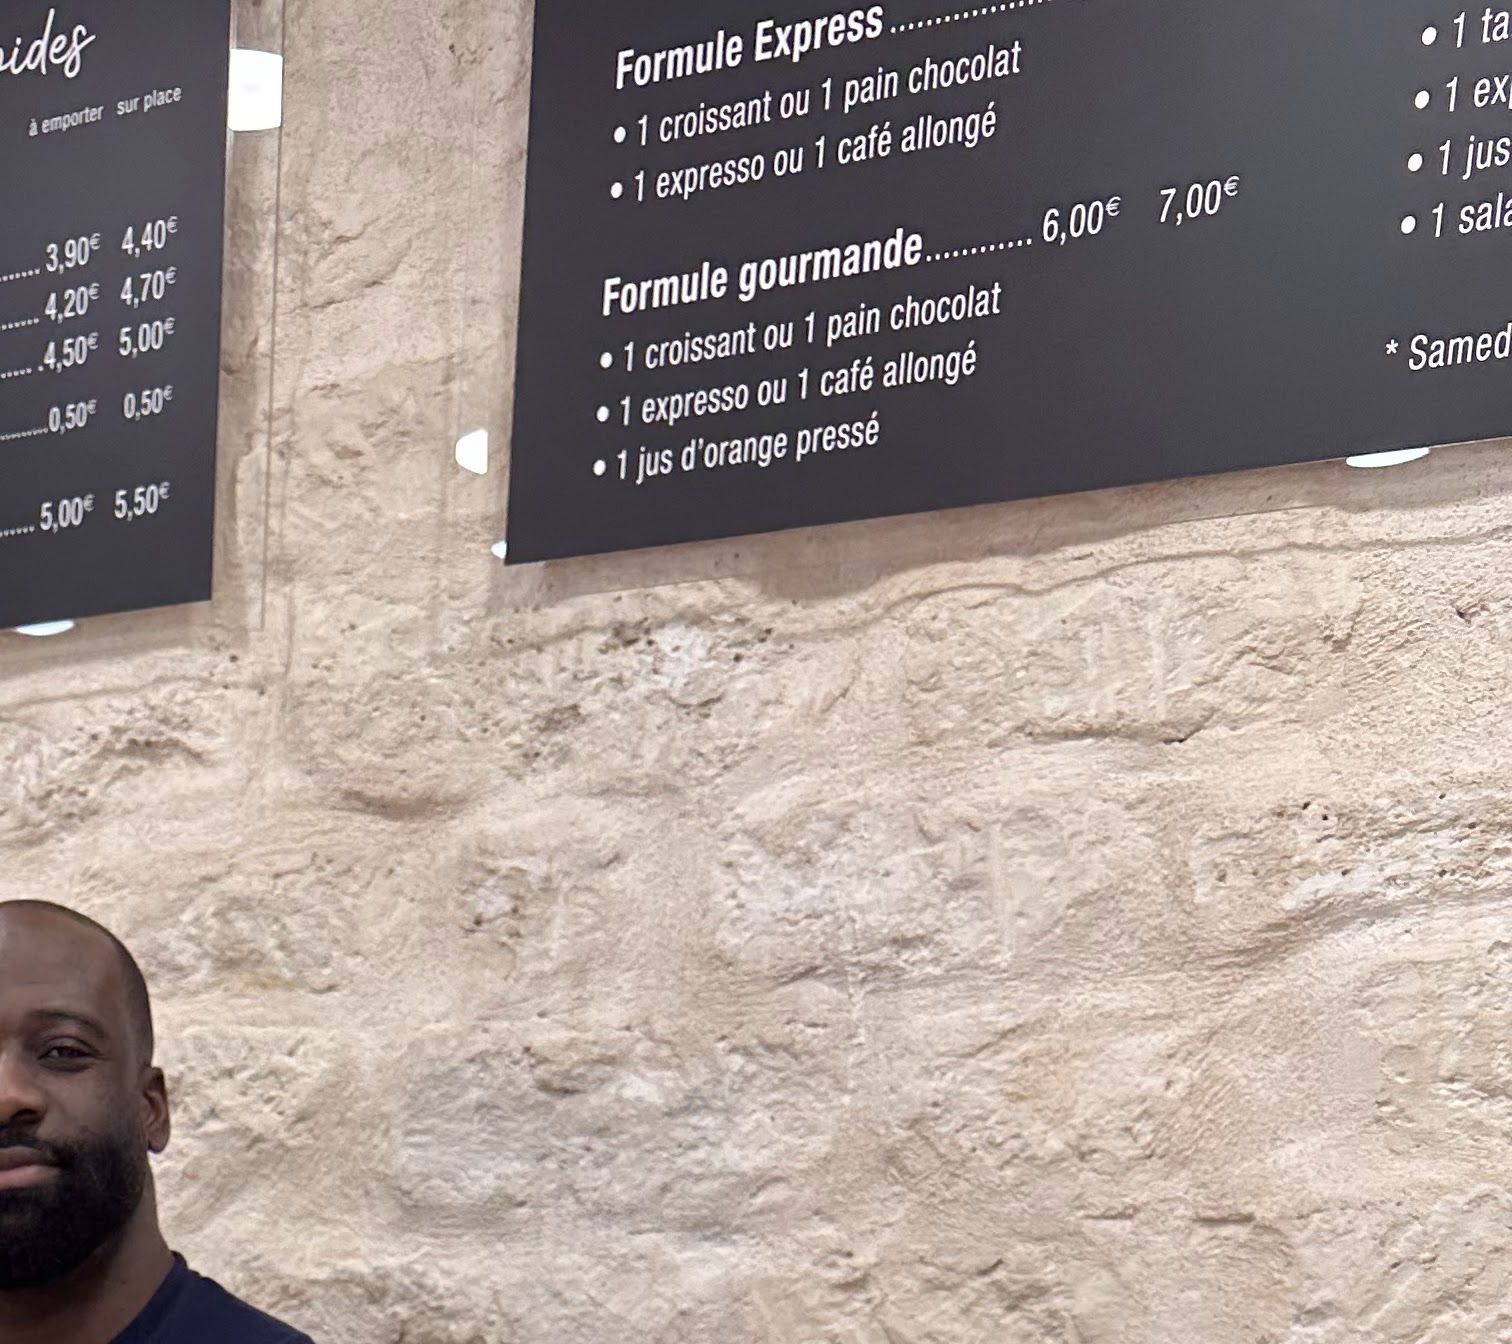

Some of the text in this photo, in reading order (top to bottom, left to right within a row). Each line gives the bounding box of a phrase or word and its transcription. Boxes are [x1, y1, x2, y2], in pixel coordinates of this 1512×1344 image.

[615, 5, 884, 89] Formule Express
[1454, 11, 1465, 48] 1
[29, 102, 104, 136] à emporter
[117, 84, 182, 116] sur place
[638, 40, 1021, 146] 1 croissant ou 1 pain chocolat
[1446, 75, 1512, 112] 1 ex
[635, 102, 997, 202] 1 expresso ou 1 café allongé
[1439, 139, 1452, 175] 1
[46, 233, 101, 275] 3,90€
[121, 216, 178, 258] 4,40€
[602, 175, 1240, 316] Formule gourmande 6,00€ 7,00€
[1432, 202, 1444, 238] 1
[44, 282, 100, 324] 4,20€
[120, 266, 177, 308] 4,70€
[624, 282, 1001, 372] 1 croissant ou 1 pain chocolat
[48, 400, 97, 435] 0,50€
[123, 386, 173, 420] 0,50€
[621, 341, 977, 426] 1 expresso ou 1 café allongé
[617, 411, 880, 484] 1 jus d'orange pressé
[39, 494, 95, 532] 5,00€
[115, 481, 170, 521] 5,50€
